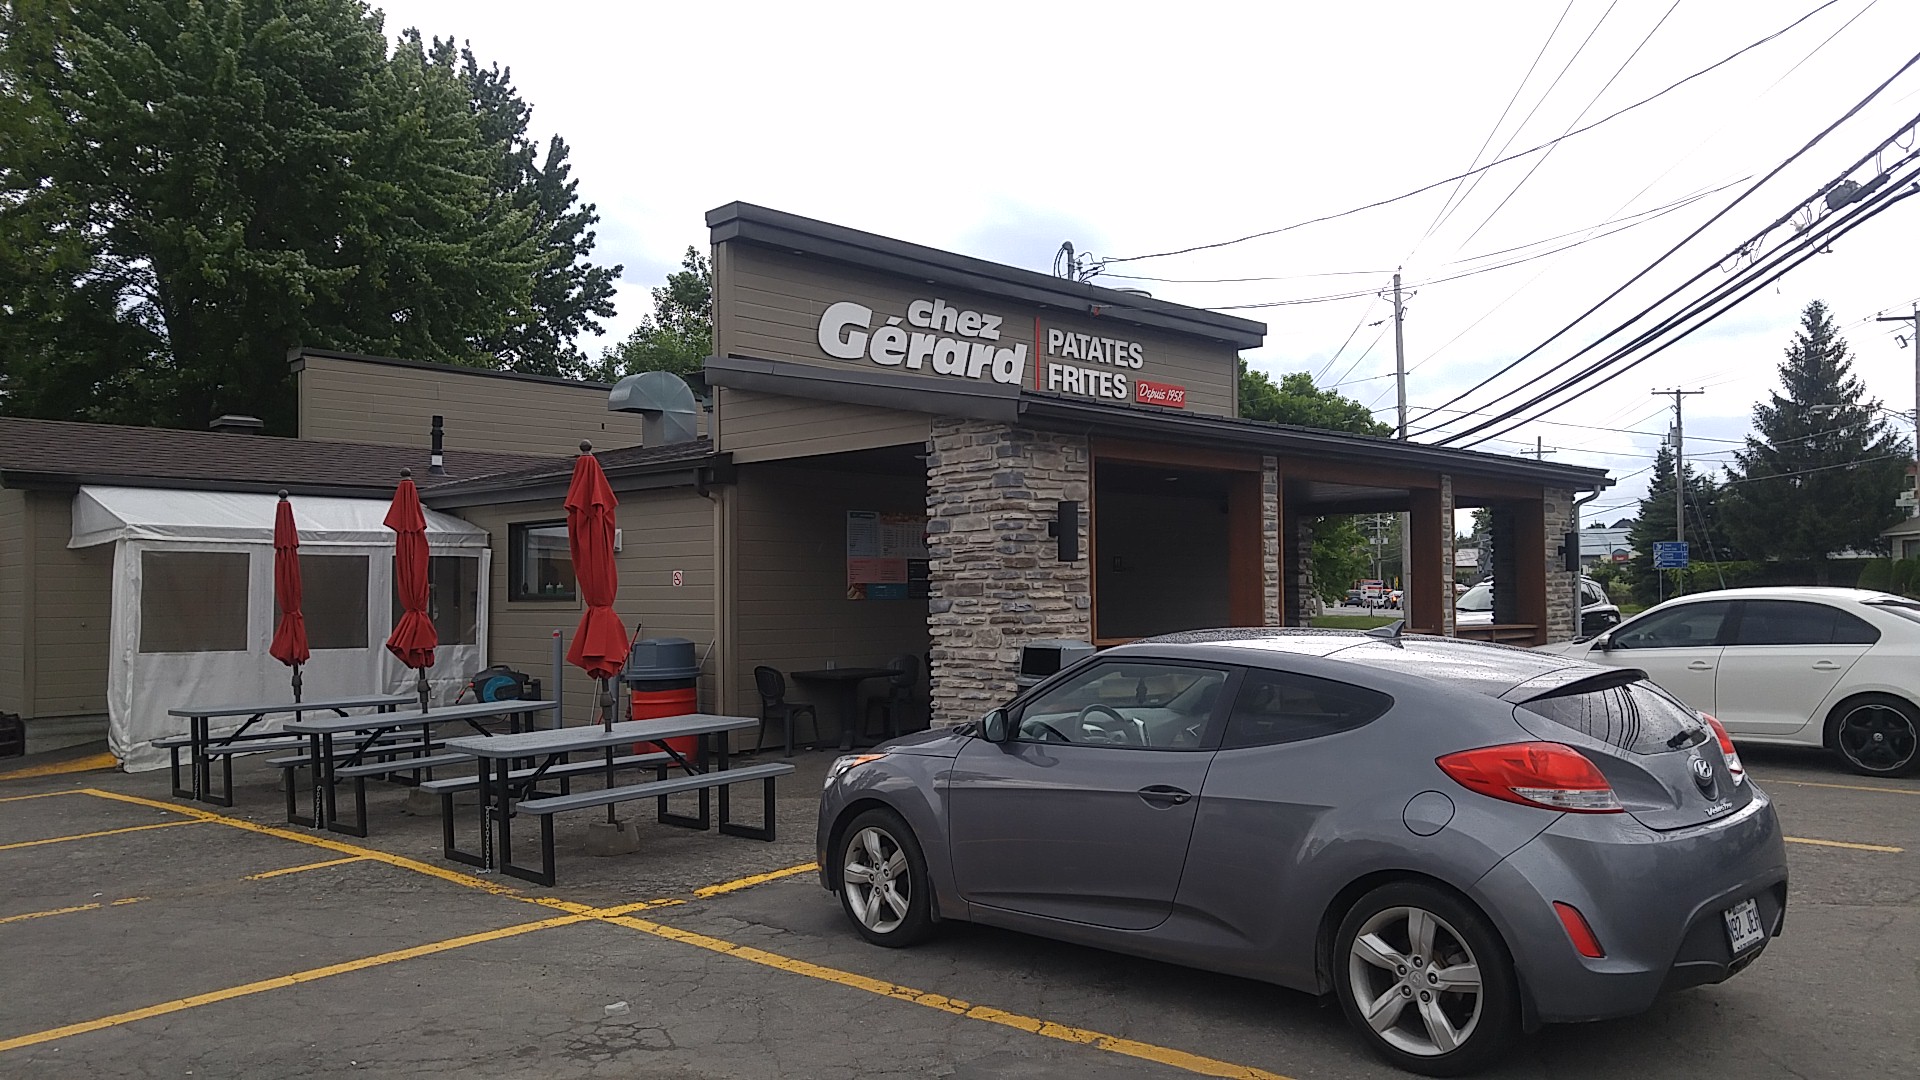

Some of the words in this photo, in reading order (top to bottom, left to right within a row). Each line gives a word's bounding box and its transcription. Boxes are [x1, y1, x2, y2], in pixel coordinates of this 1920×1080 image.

[907, 298, 1003, 341] chez
[818, 301, 1028, 385] Gérard
[1048, 328, 1144, 369] PATATES
[1048, 362, 1128, 399] FRITES
[1139, 383, 1166, 403] Depuis
[1166, 389, 1185, 402] 1958
